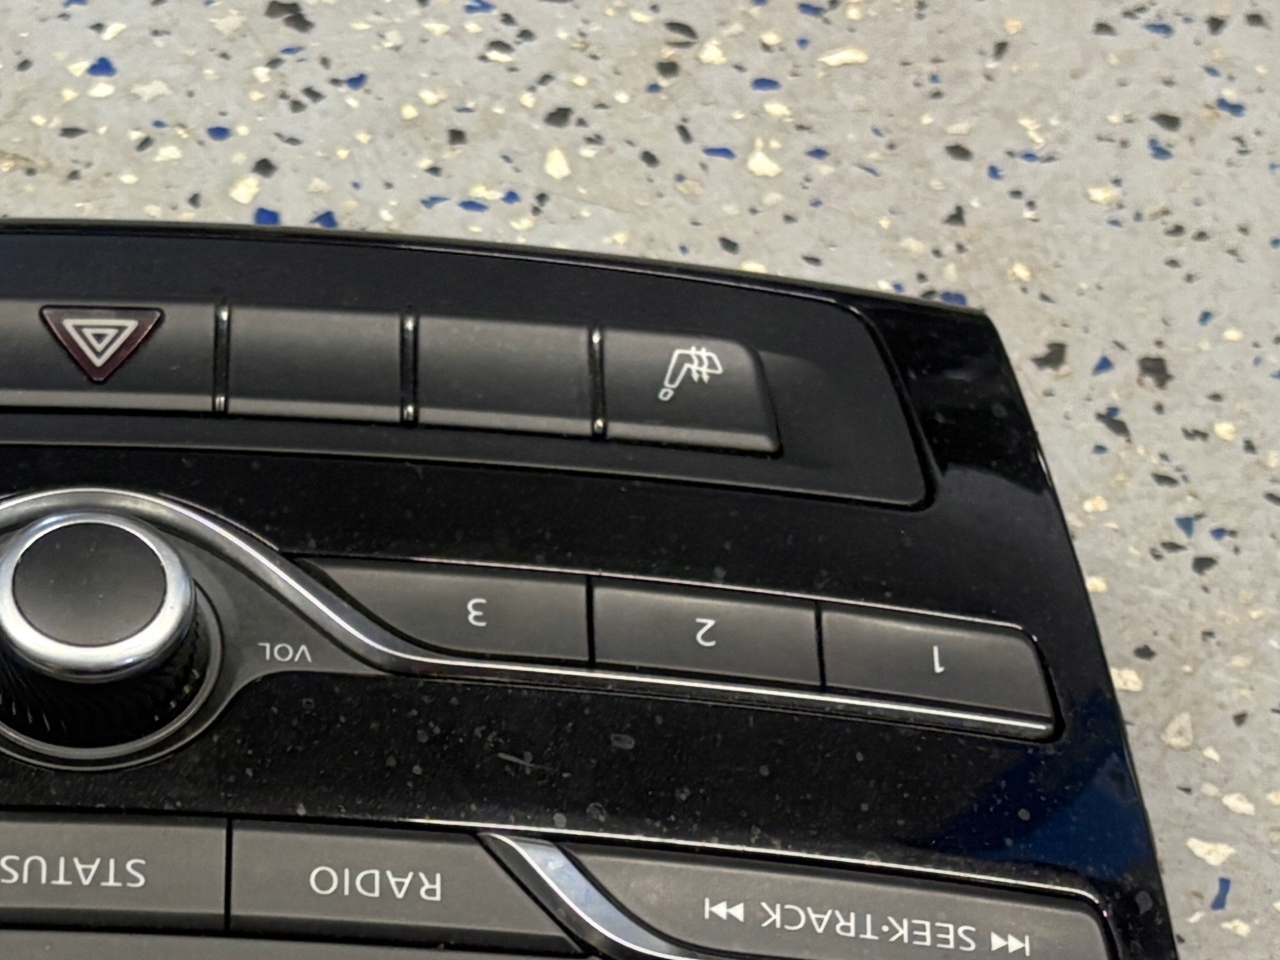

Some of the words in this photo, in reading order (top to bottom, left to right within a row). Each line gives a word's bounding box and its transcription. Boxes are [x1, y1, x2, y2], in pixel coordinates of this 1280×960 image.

[466, 597, 488, 627] 3
[695, 617, 716, 647] 2
[257, 642, 312, 663] VOL
[932, 645, 945, 674] 1
[0, 854, 146, 888] STATUS
[309, 865, 442, 902] RADIO
